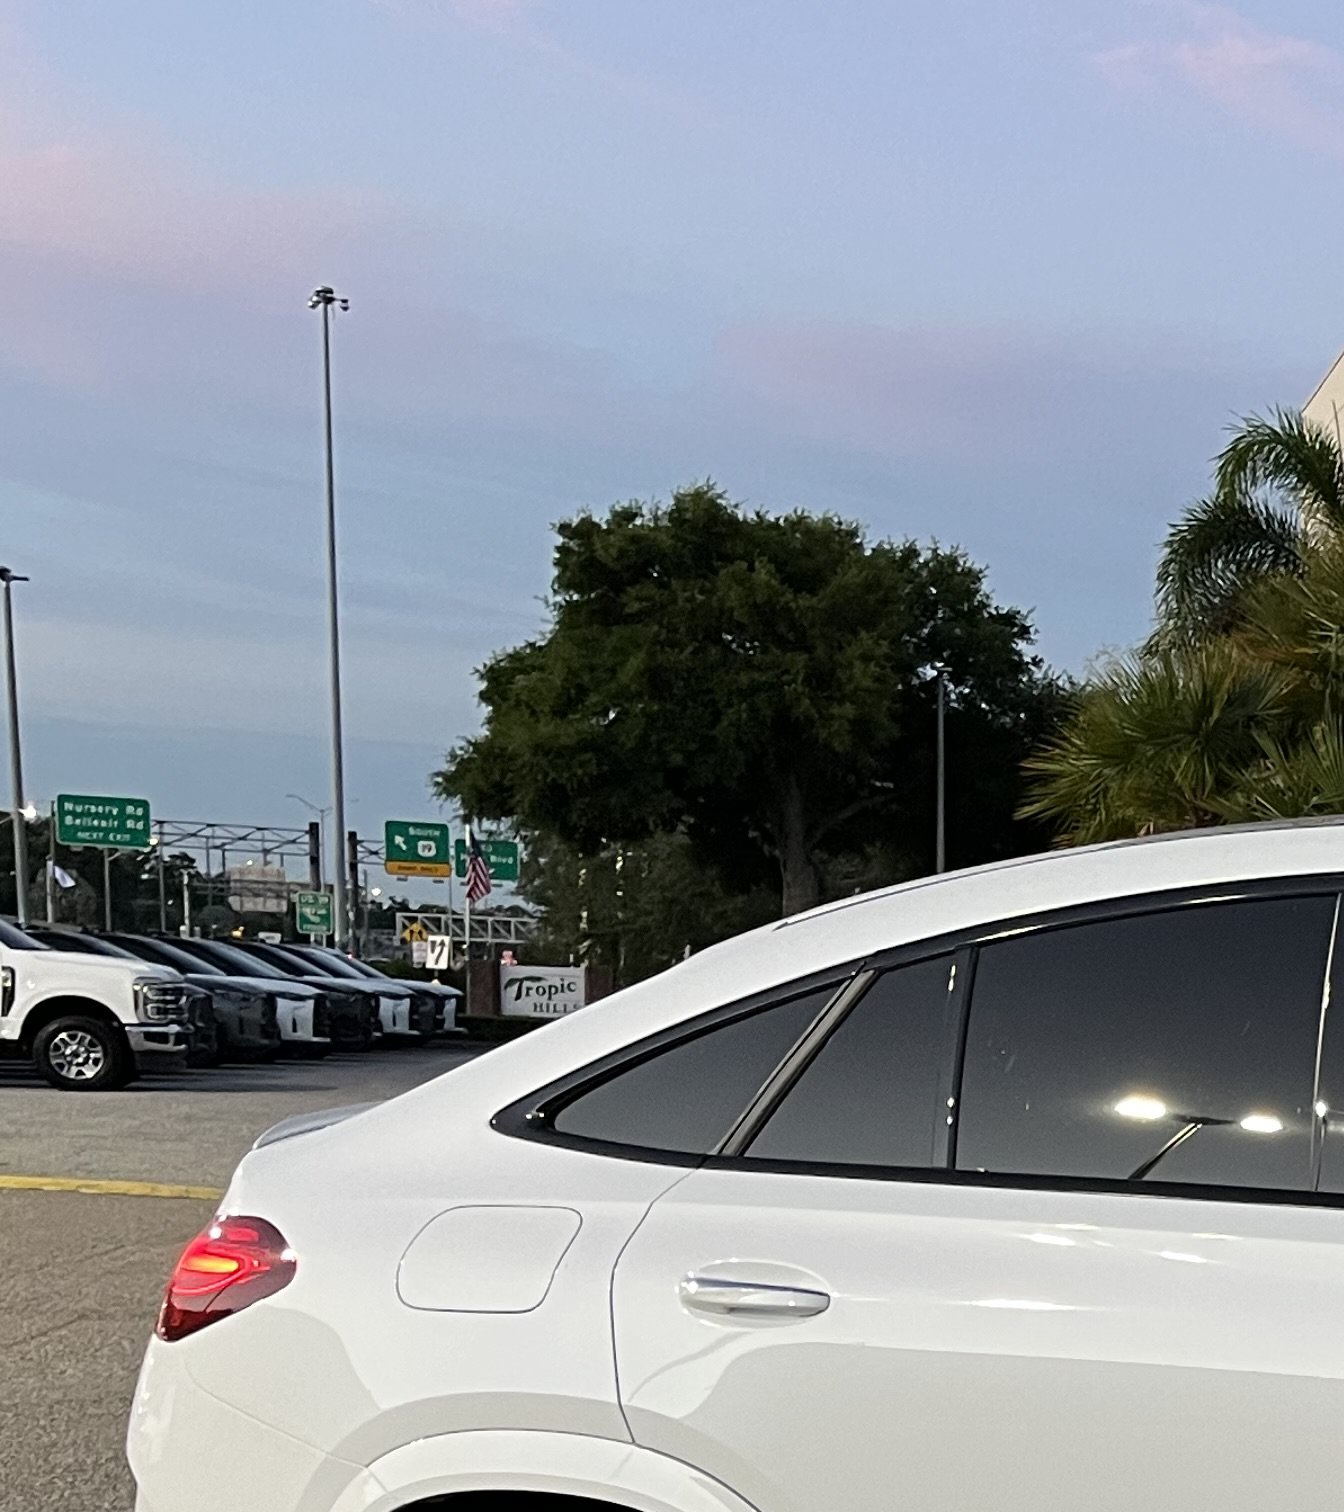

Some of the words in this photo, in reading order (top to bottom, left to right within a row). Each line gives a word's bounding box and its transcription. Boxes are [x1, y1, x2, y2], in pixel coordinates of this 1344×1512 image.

[64, 802, 118, 815] Nursery
[126, 805, 143, 816] Rd
[126, 819, 143, 830] Rd
[504, 975, 576, 1001] Tropic
